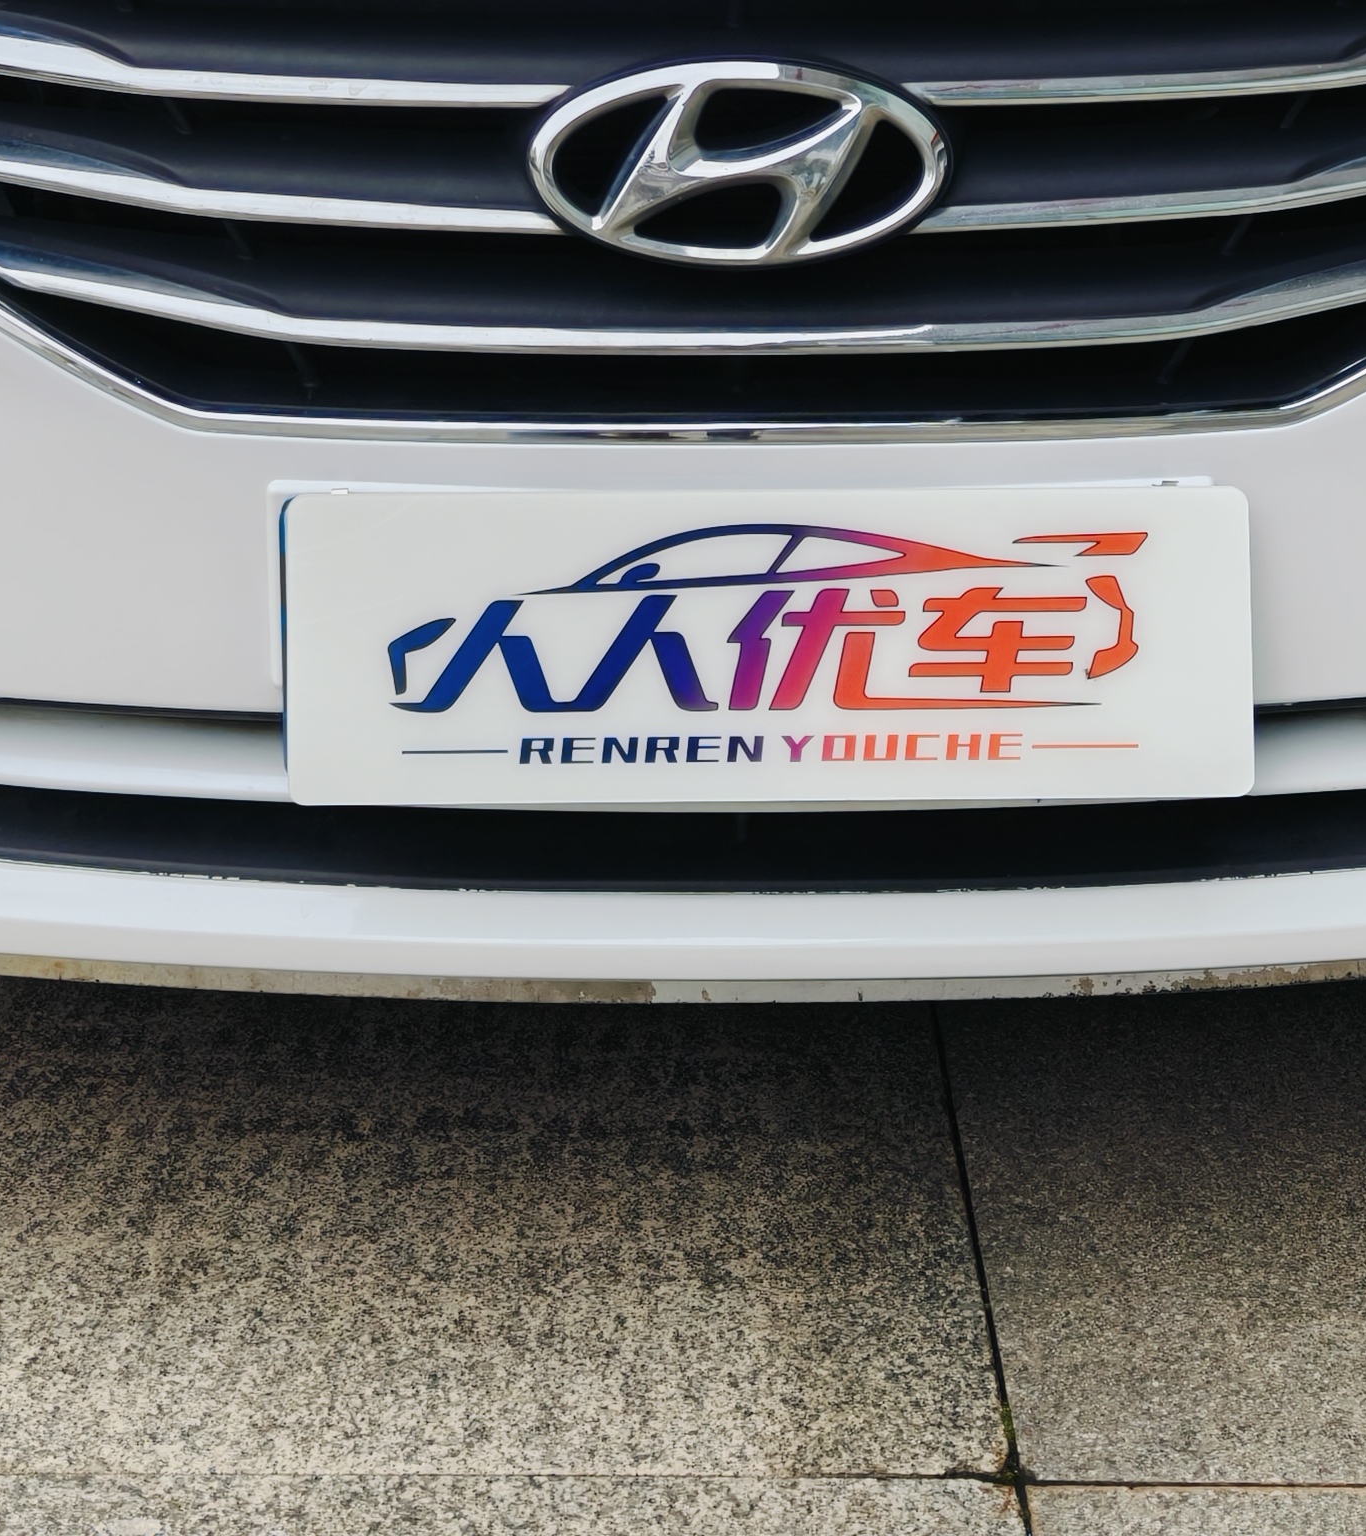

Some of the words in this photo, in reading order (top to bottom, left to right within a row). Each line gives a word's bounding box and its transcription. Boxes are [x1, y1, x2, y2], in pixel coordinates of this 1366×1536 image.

[389, 588, 1102, 713] 人人优车
[518, 735, 764, 765] RENREN
[781, 733, 1024, 763] YOUCHE
